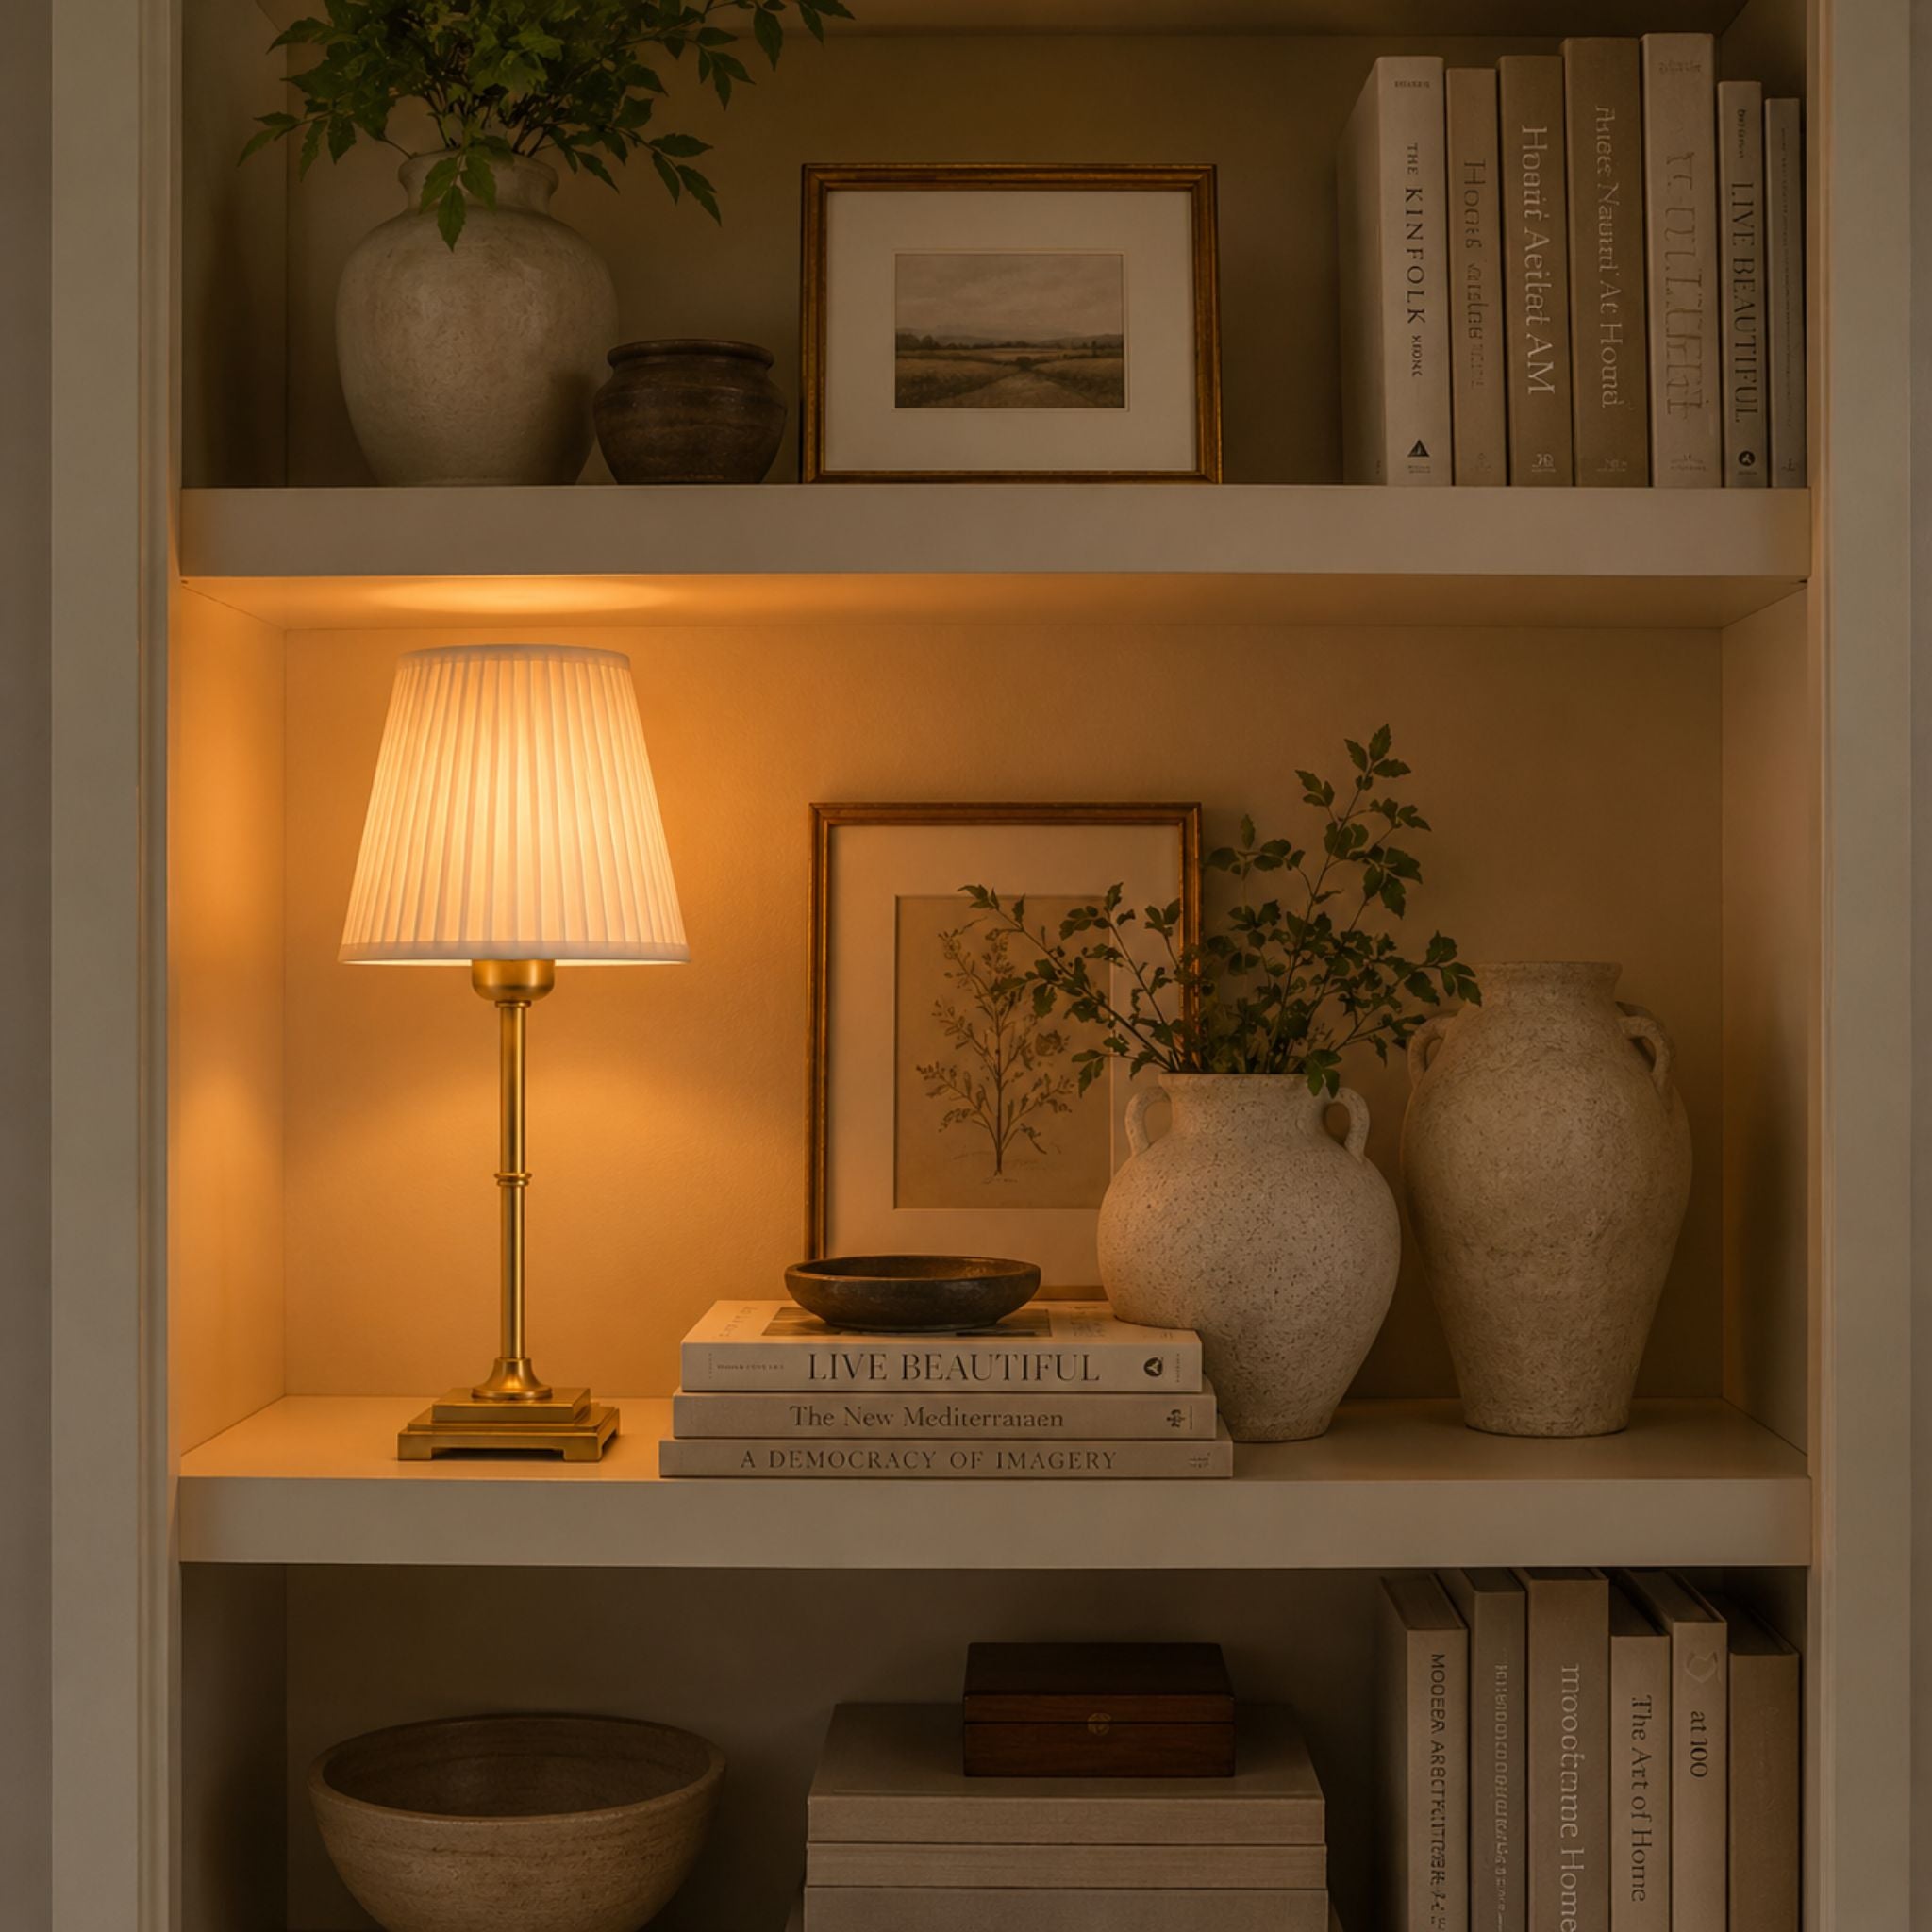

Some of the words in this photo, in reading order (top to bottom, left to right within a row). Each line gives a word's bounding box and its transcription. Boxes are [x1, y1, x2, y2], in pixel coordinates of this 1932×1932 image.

[1407, 142, 1419, 175] THE
[1731, 182, 1755, 246] LIVE
[1405, 188, 1425, 325] KINFOLK
[1732, 257, 1758, 424] BEAUTIFUL
[808, 1354, 887, 1380] LIVE
[902, 1354, 1101, 1382] BEAUTIFUL
[789, 1406, 835, 1427] The
[843, 1406, 894, 1427] New
[740, 1451, 756, 1469] A
[769, 1450, 937, 1469] DEMOCRACY
[950, 1450, 984, 1470] OF
[997, 1450, 1118, 1470] IMAGERY
[1631, 1694, 1653, 1740] The
[1690, 1710, 1707, 1733] at
[1631, 1747, 1653, 1790] Art
[1689, 1737, 1708, 1778] 100
[1631, 1795, 1653, 1824] of
[1631, 1828, 1653, 1902] Home
[1560, 1846, 1586, 1932] Home
